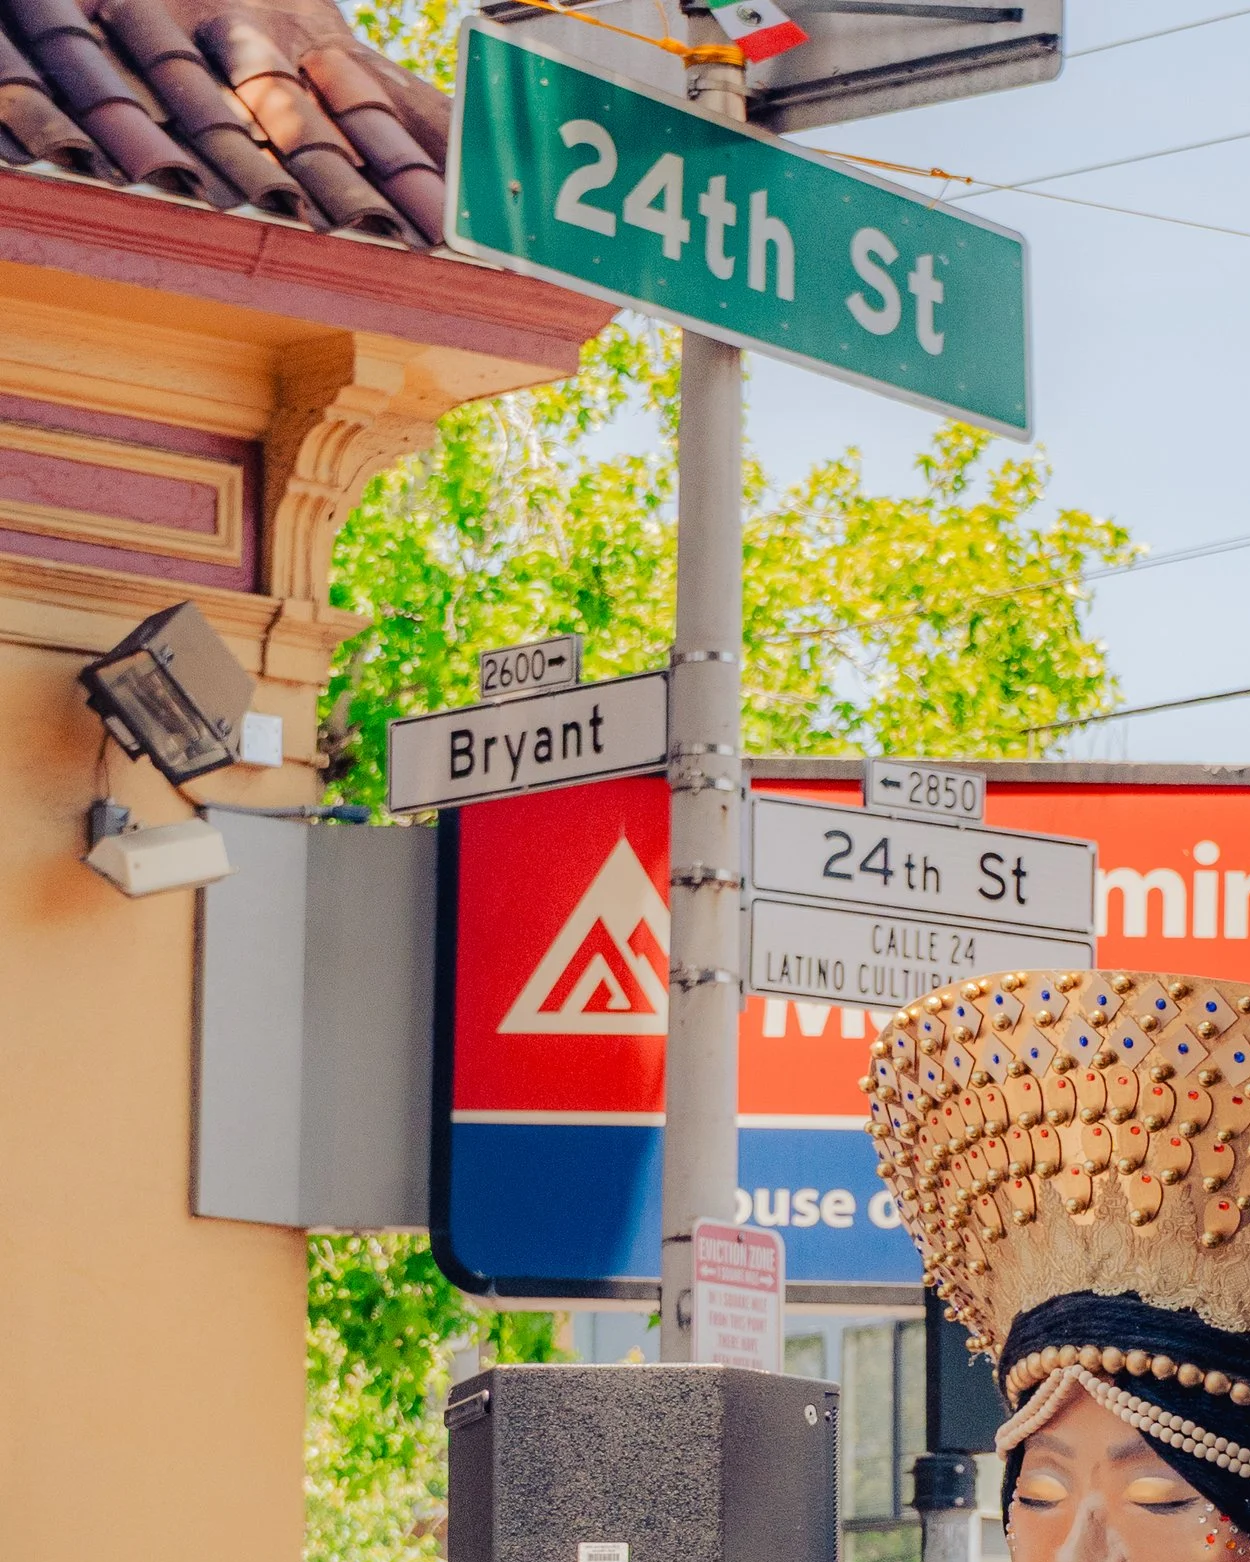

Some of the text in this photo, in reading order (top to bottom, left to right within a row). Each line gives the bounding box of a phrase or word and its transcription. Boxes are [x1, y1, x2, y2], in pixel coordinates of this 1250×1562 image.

[555, 119, 946, 357] 24th St
[484, 649, 546, 691] 2600
[450, 704, 605, 782] Bryant
[908, 771, 977, 814] 2850
[822, 829, 1028, 905] 24th St
[872, 924, 976, 967] CALLE 24
[767, 952, 964, 999] LATINO CULTUR
[734, 1187, 902, 1229] ouse o
[700, 1237, 776, 1271] EVICTION ZONE
